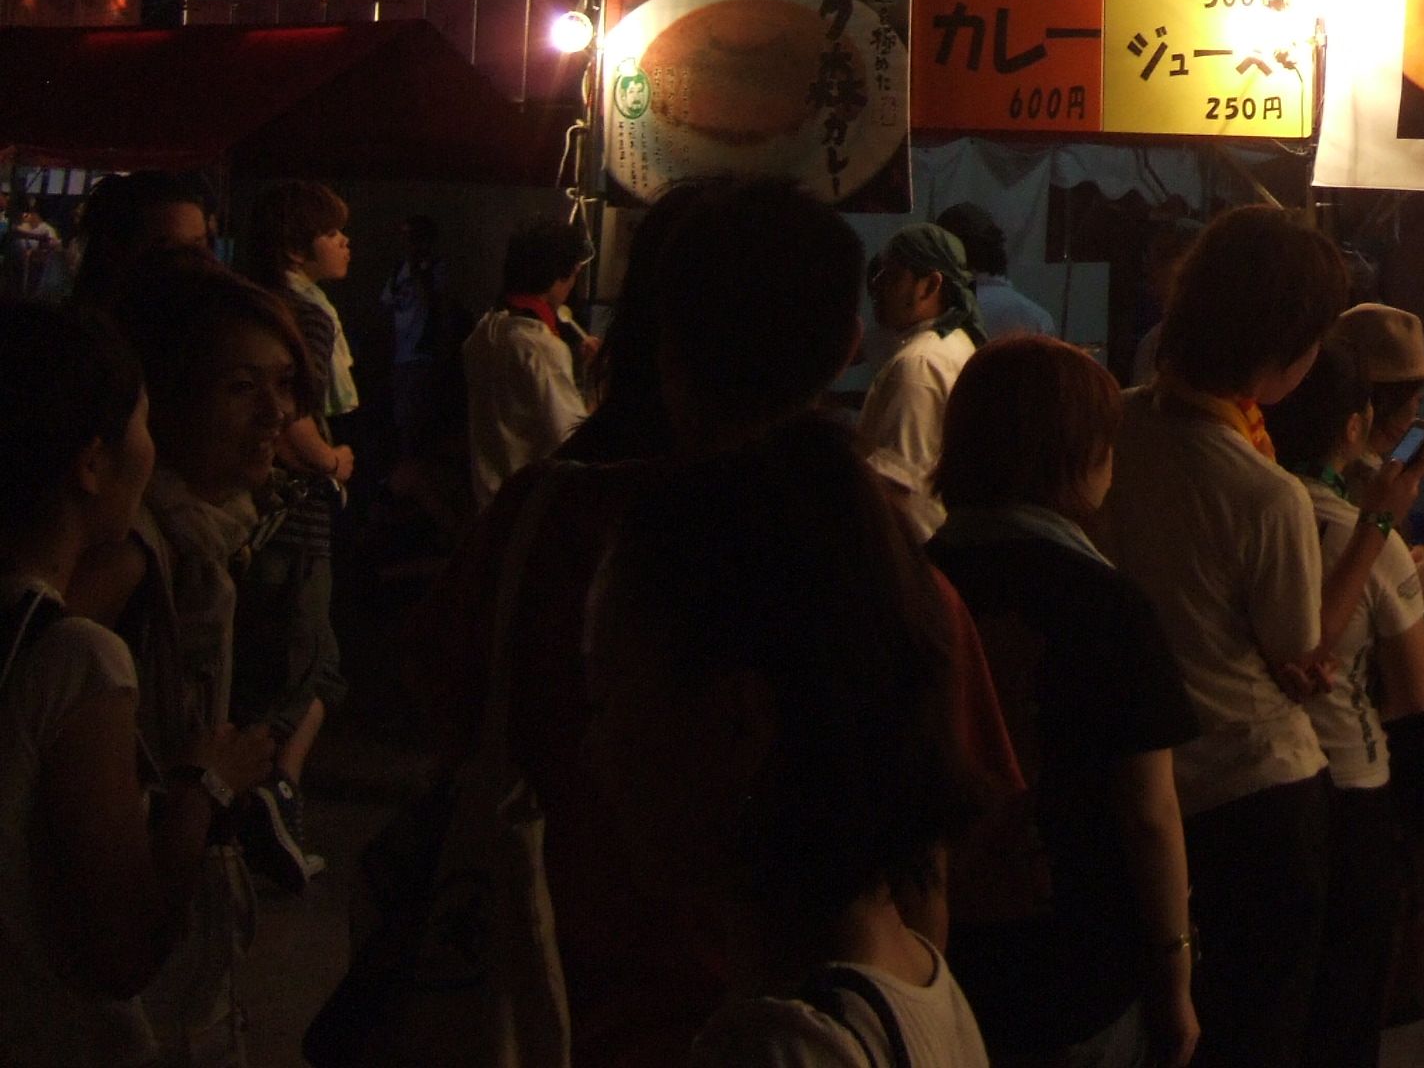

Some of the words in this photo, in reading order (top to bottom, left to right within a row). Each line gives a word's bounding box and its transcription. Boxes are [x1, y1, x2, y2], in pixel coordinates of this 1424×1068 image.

[933, 2, 1101, 74] カレー
[1009, 85, 1086, 120] 600円
[1205, 96, 1283, 121] 250円
